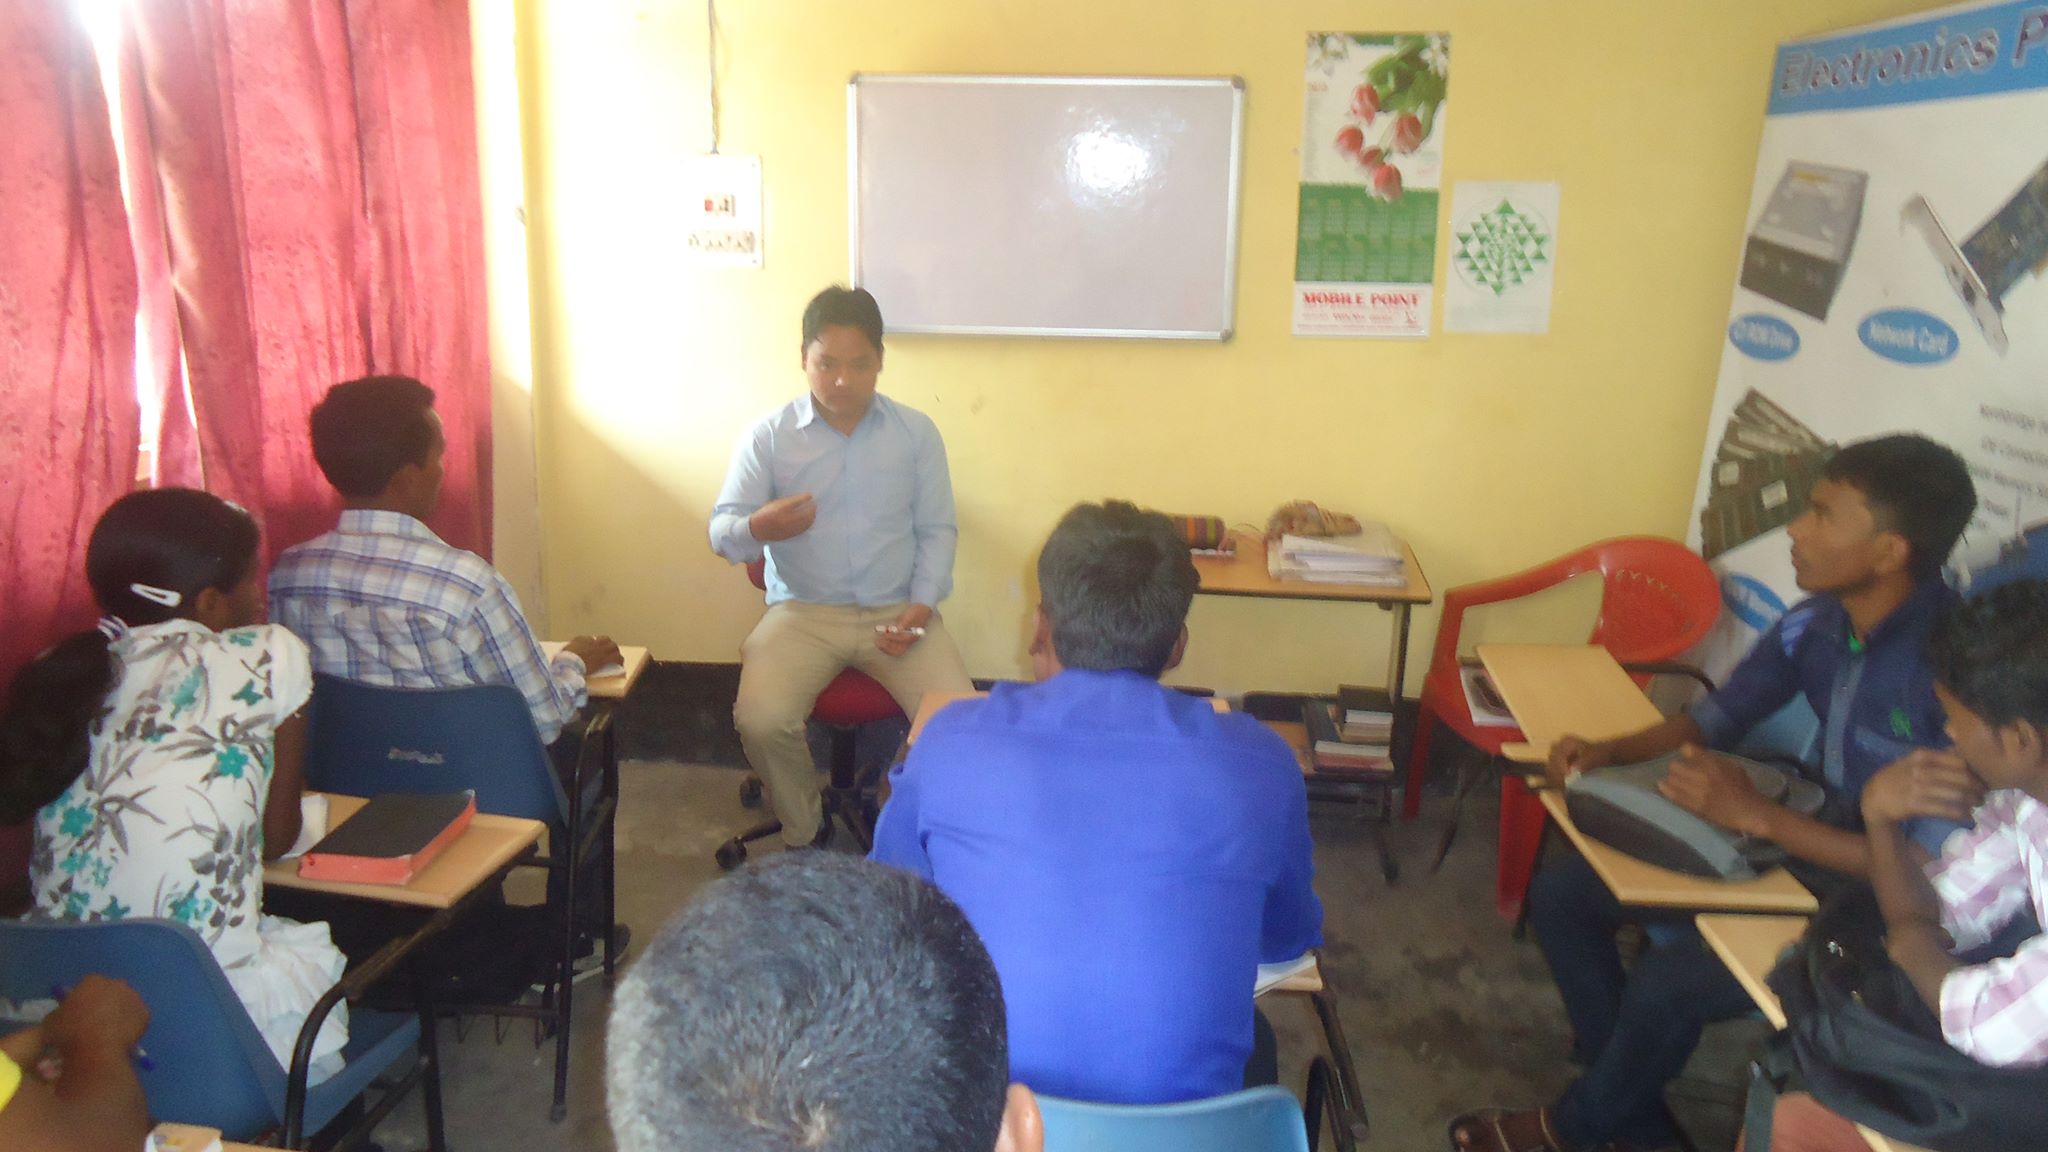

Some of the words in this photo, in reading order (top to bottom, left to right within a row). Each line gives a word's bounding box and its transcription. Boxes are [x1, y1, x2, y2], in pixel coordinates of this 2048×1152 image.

[1780, 25, 1999, 97] Electronics
[1302, 291, 1364, 306] MOBILE
[1370, 292, 1420, 308] POINT
[1869, 319, 1915, 348] Network
[1918, 326, 1949, 355] Card
